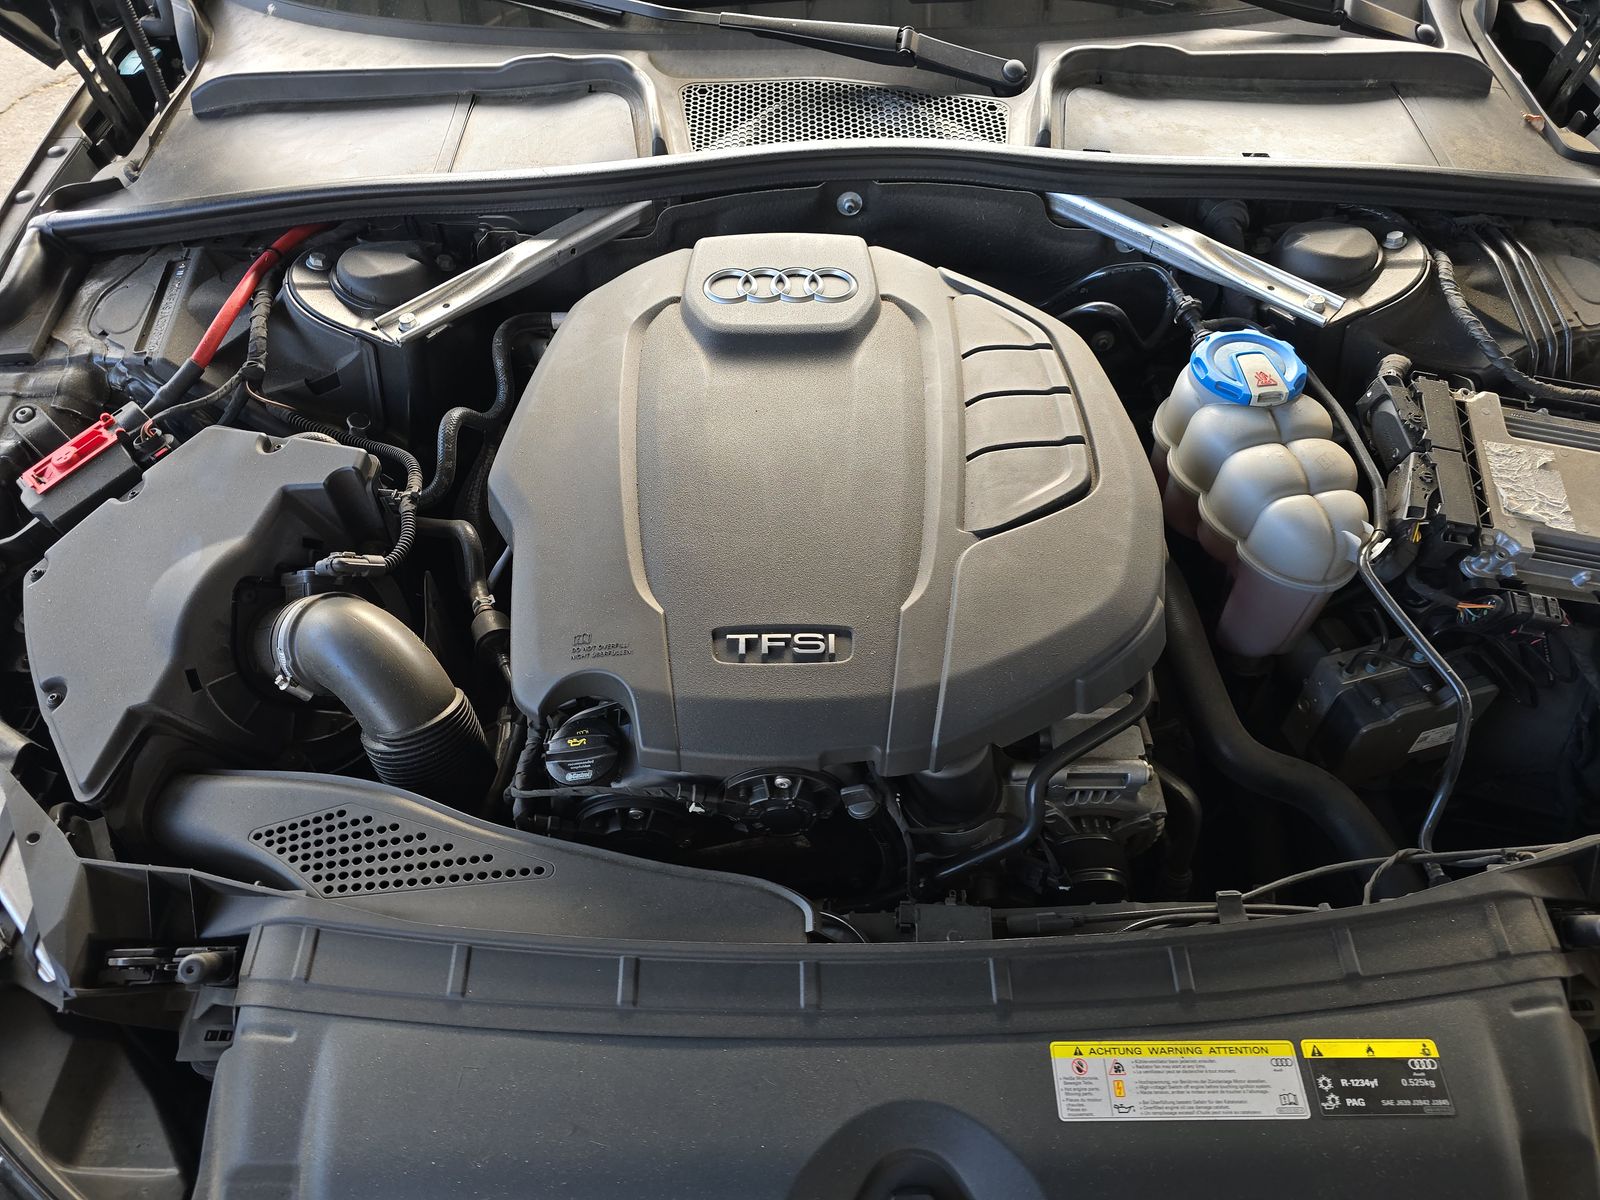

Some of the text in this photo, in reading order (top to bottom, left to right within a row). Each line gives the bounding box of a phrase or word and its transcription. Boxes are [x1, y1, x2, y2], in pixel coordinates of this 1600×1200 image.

[726, 633, 835, 655] TFSI
[1089, 1046, 1269, 1055] ACHTUNG WARNING ATTENTION
[1340, 1078, 1379, 1089] R-1234yf
[1400, 1078, 1436, 1089] 0.525kg
[1345, 1098, 1366, 1107] PAG
